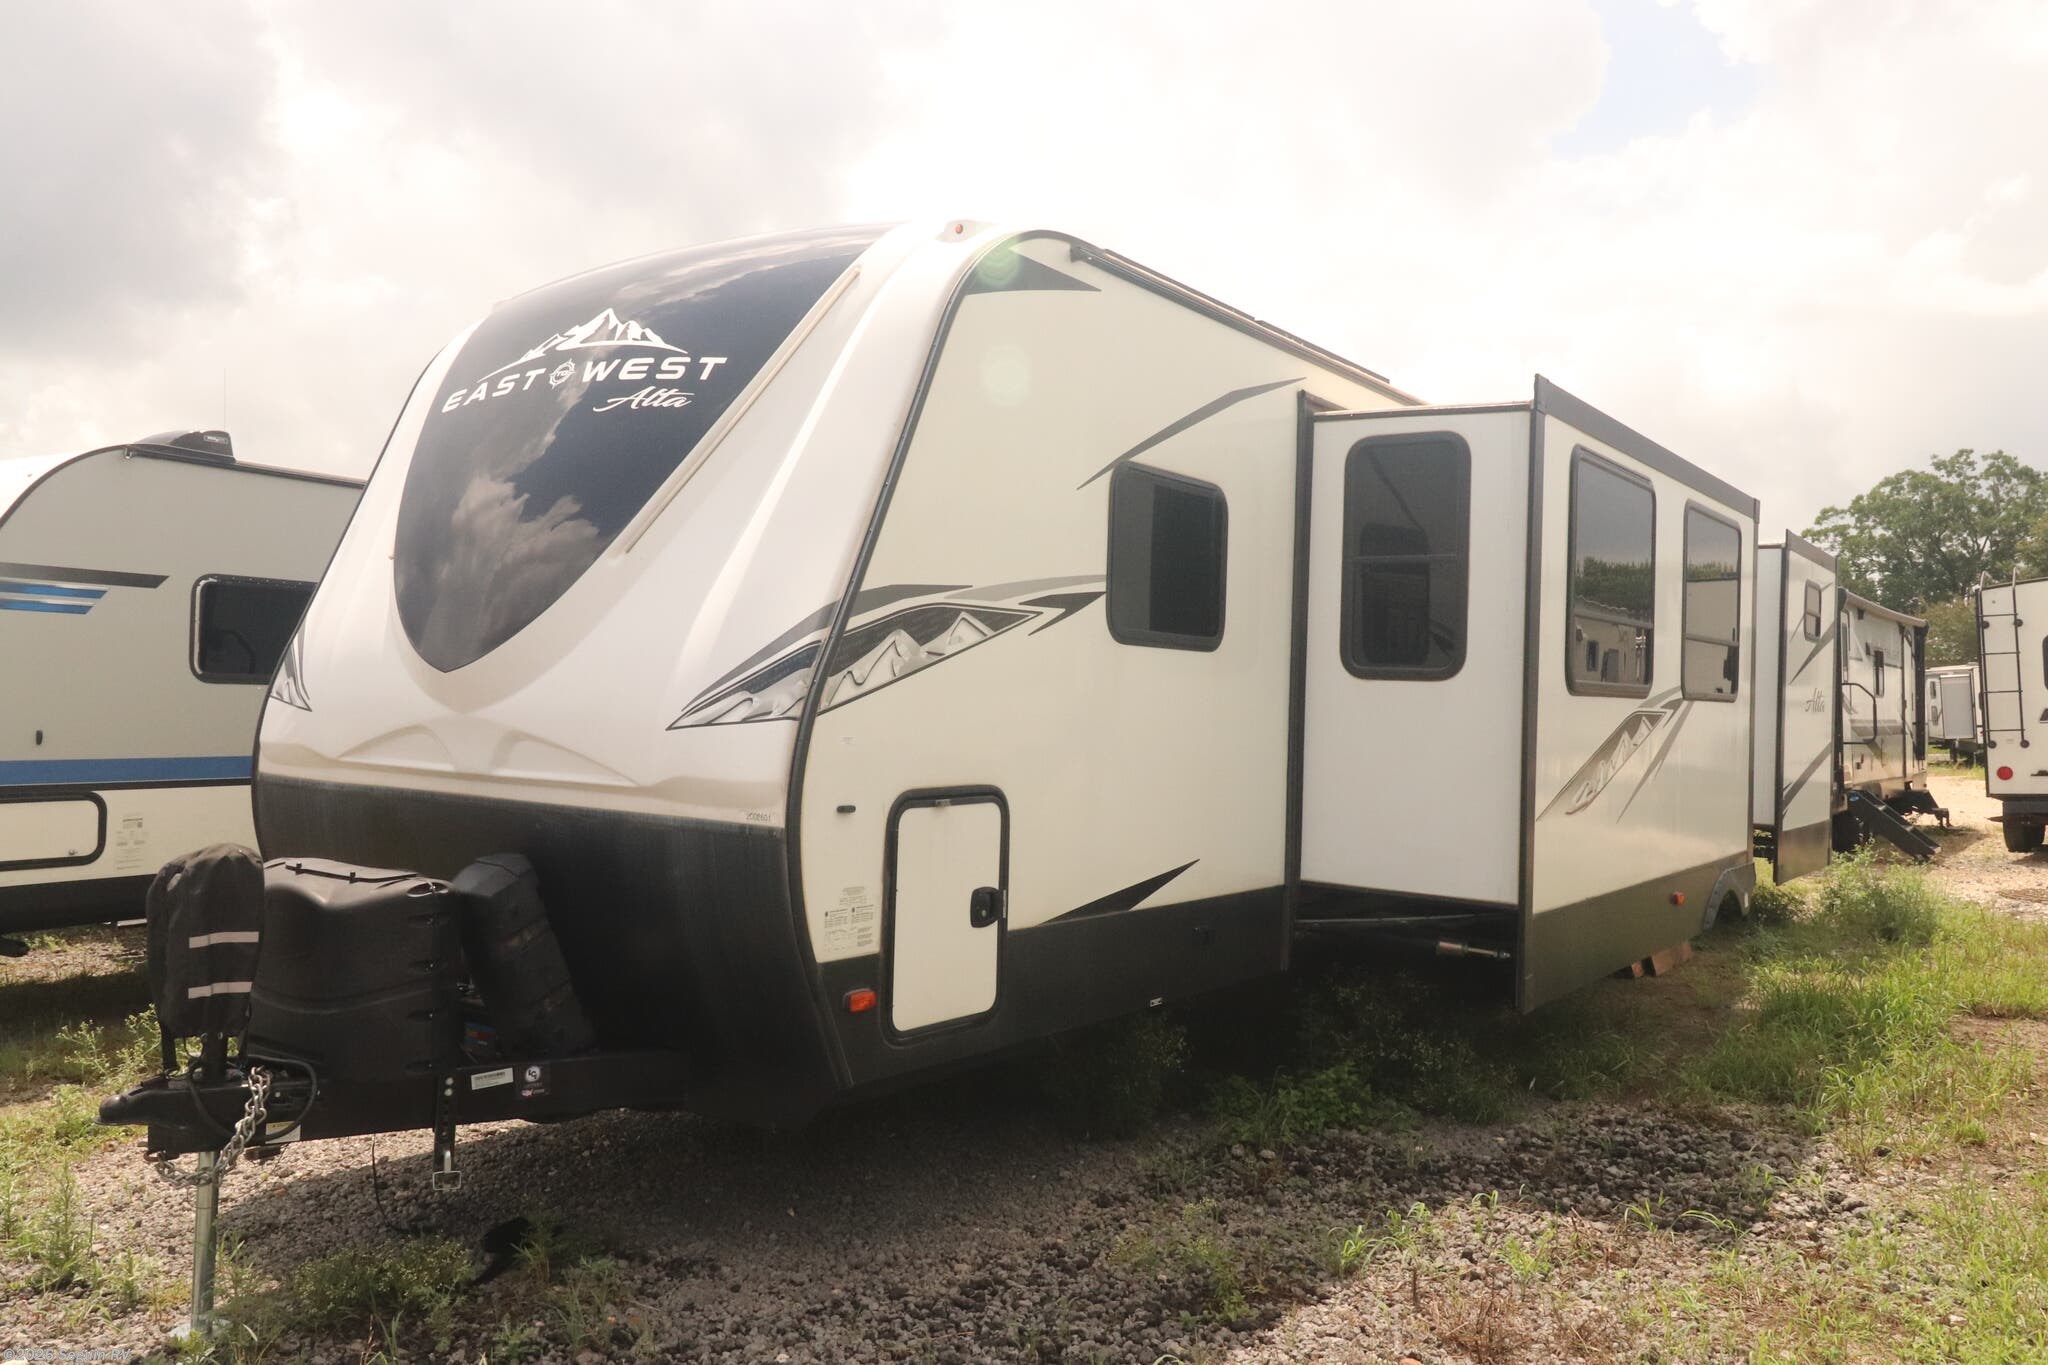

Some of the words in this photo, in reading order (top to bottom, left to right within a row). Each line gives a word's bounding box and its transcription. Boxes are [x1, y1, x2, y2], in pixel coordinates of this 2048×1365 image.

[442, 368, 546, 413] EAST
[582, 356, 728, 382] WEST
[593, 385, 696, 412] Alta
[1804, 687, 1825, 713] Alta
